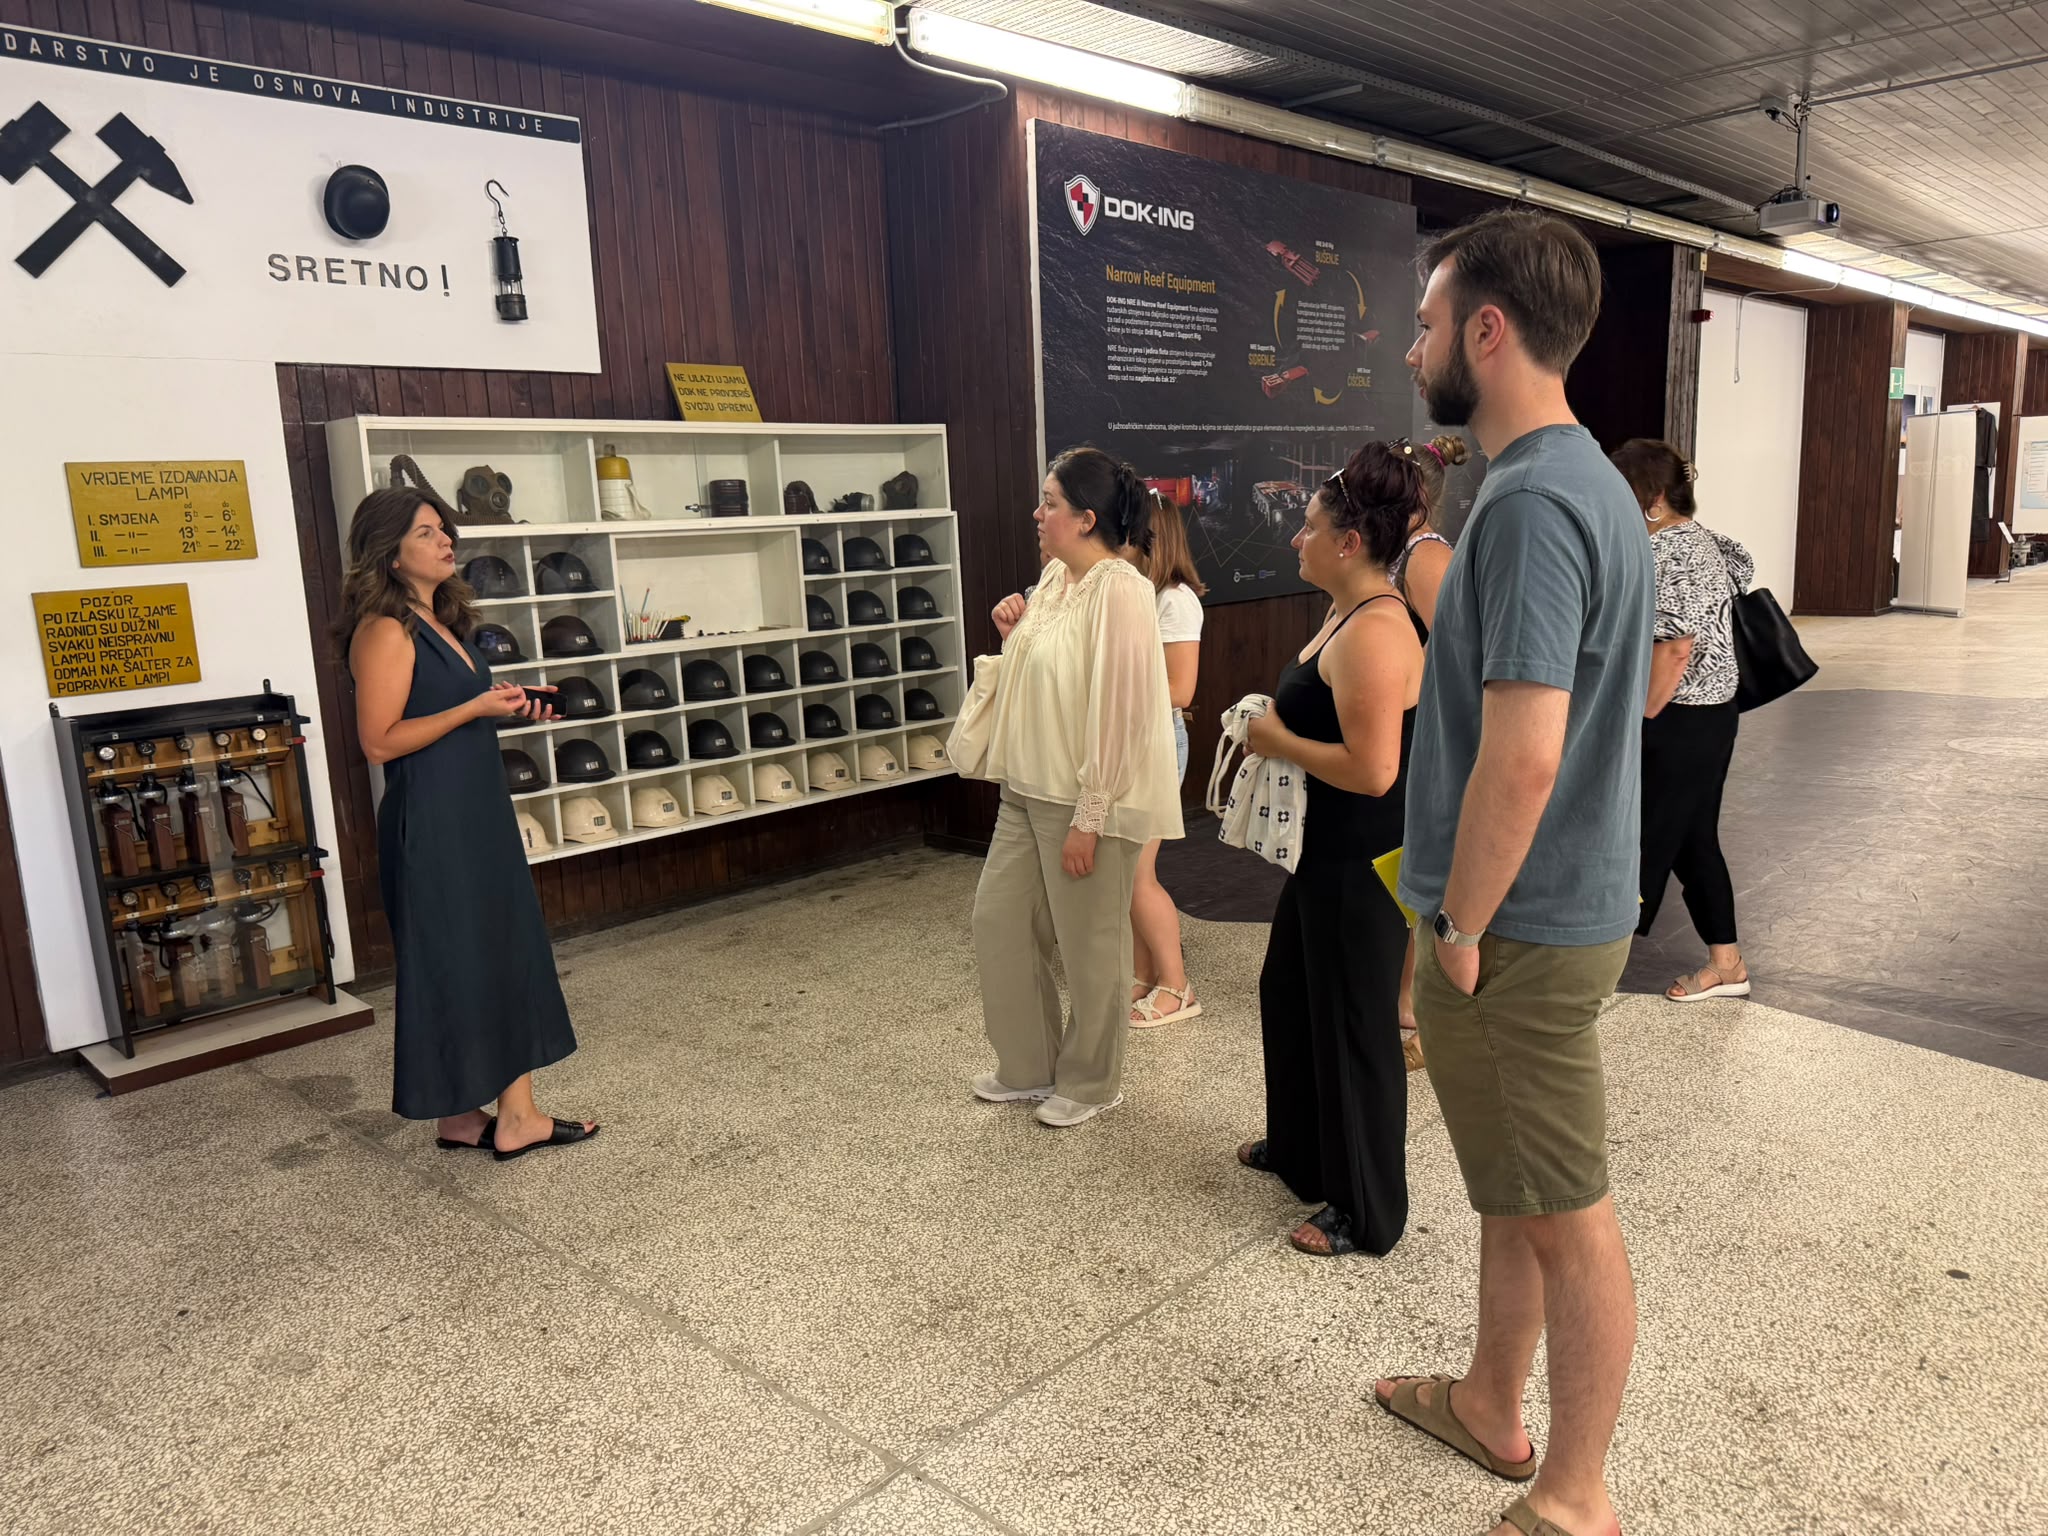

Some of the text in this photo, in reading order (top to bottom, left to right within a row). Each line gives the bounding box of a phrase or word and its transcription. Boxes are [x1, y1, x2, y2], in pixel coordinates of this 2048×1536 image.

[189, 64, 219, 82] JE
[253, 73, 361, 105] OSNOVA
[391, 95, 543, 133] INDUSTRIJE
[1104, 196, 1194, 231] DOK-ING
[1315, 250, 1340, 266] BUŠENJE
[1106, 264, 1216, 294] Narrow Reef Equipment
[1248, 353, 1276, 367] SIDRENJE
[688, 375, 714, 383] ULAZI
[715, 375, 722, 383] U
[724, 376, 746, 384] JAMU
[710, 388, 750, 397] PROVJERIŠ
[684, 402, 753, 412] SVOJU OPREMU
[81, 470, 238, 485] VRIJEME IZDAVANJA
[136, 487, 189, 500] LAMPI
[100, 513, 159, 525] SMJENA
[90, 531, 100, 542] II.
[94, 546, 107, 557] III.
[80, 595, 133, 608] POZOR
[43, 604, 177, 625] PO IZLASKU IZ JAME
[46, 618, 159, 639] RADNICI SU DUŽNI
[49, 632, 174, 652] SVAKU NEISPRAVNU
[52, 647, 153, 666] LAMPU PREDATI
[54, 657, 193, 680] ODMAH NA ŠALTER ZA
[57, 672, 170, 693] POPRAVKE LAMPI
